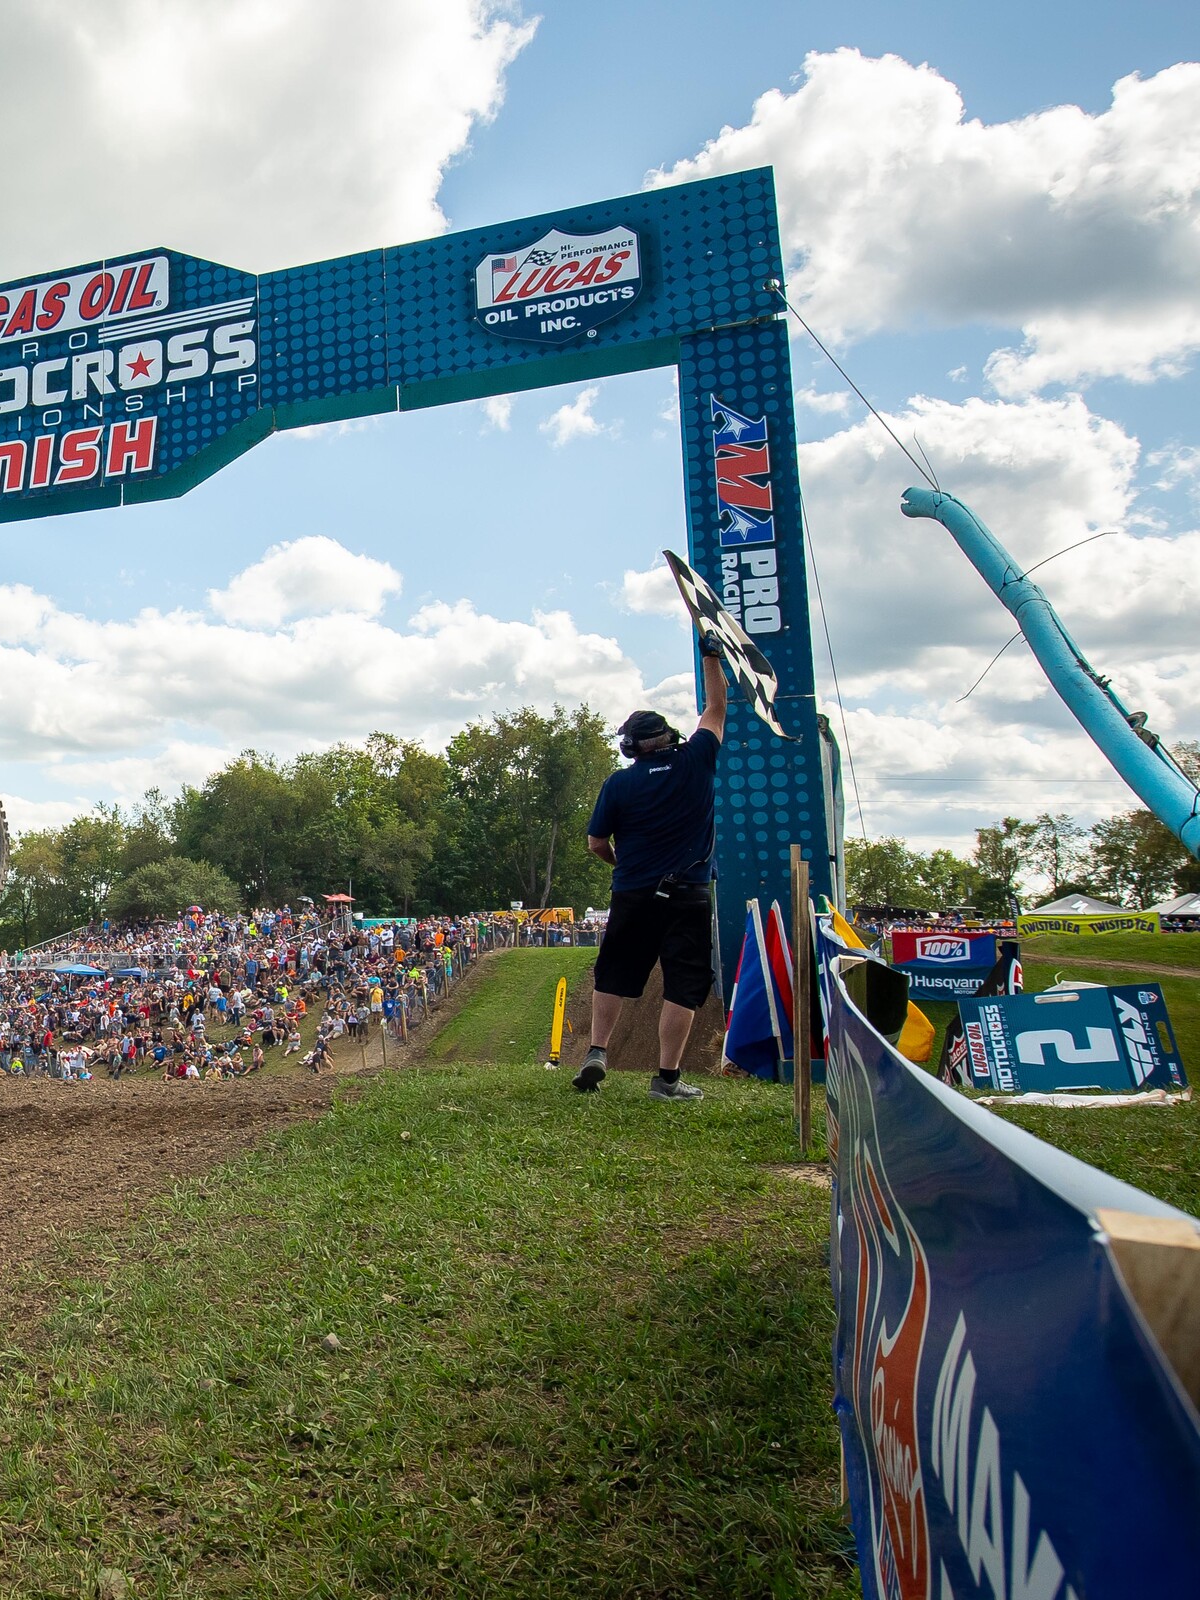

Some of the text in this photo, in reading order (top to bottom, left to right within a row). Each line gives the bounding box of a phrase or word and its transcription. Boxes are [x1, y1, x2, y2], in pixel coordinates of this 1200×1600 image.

[560, 239, 634, 260] PERFORMANCE
[78, 262, 159, 322] OIL
[492, 250, 631, 304] LUCAS
[484, 286, 635, 325] OIL PRODUCTS
[540, 315, 582, 333] INC.
[710, 392, 776, 548] AMA
[720, 552, 744, 632] RACIN
[741, 548, 782, 634] PRO
[924, 941, 963, 956] 100%
[1020, 920, 1061, 935] TWISTED
[1062, 920, 1081, 934] TEA
[1088, 918, 1155, 935] TWISTED TEA
[914, 975, 985, 991] Husqvarn
[966, 1023, 989, 1075] LUCAS OIL
[984, 1004, 1016, 1092] MOTOCROSS
[998, 1003, 1021, 1090] CHAMPIONSHIP
[1015, 1026, 1120, 1066] 2
[1112, 994, 1154, 1087] FLY
[1140, 1011, 1162, 1066] RACING
